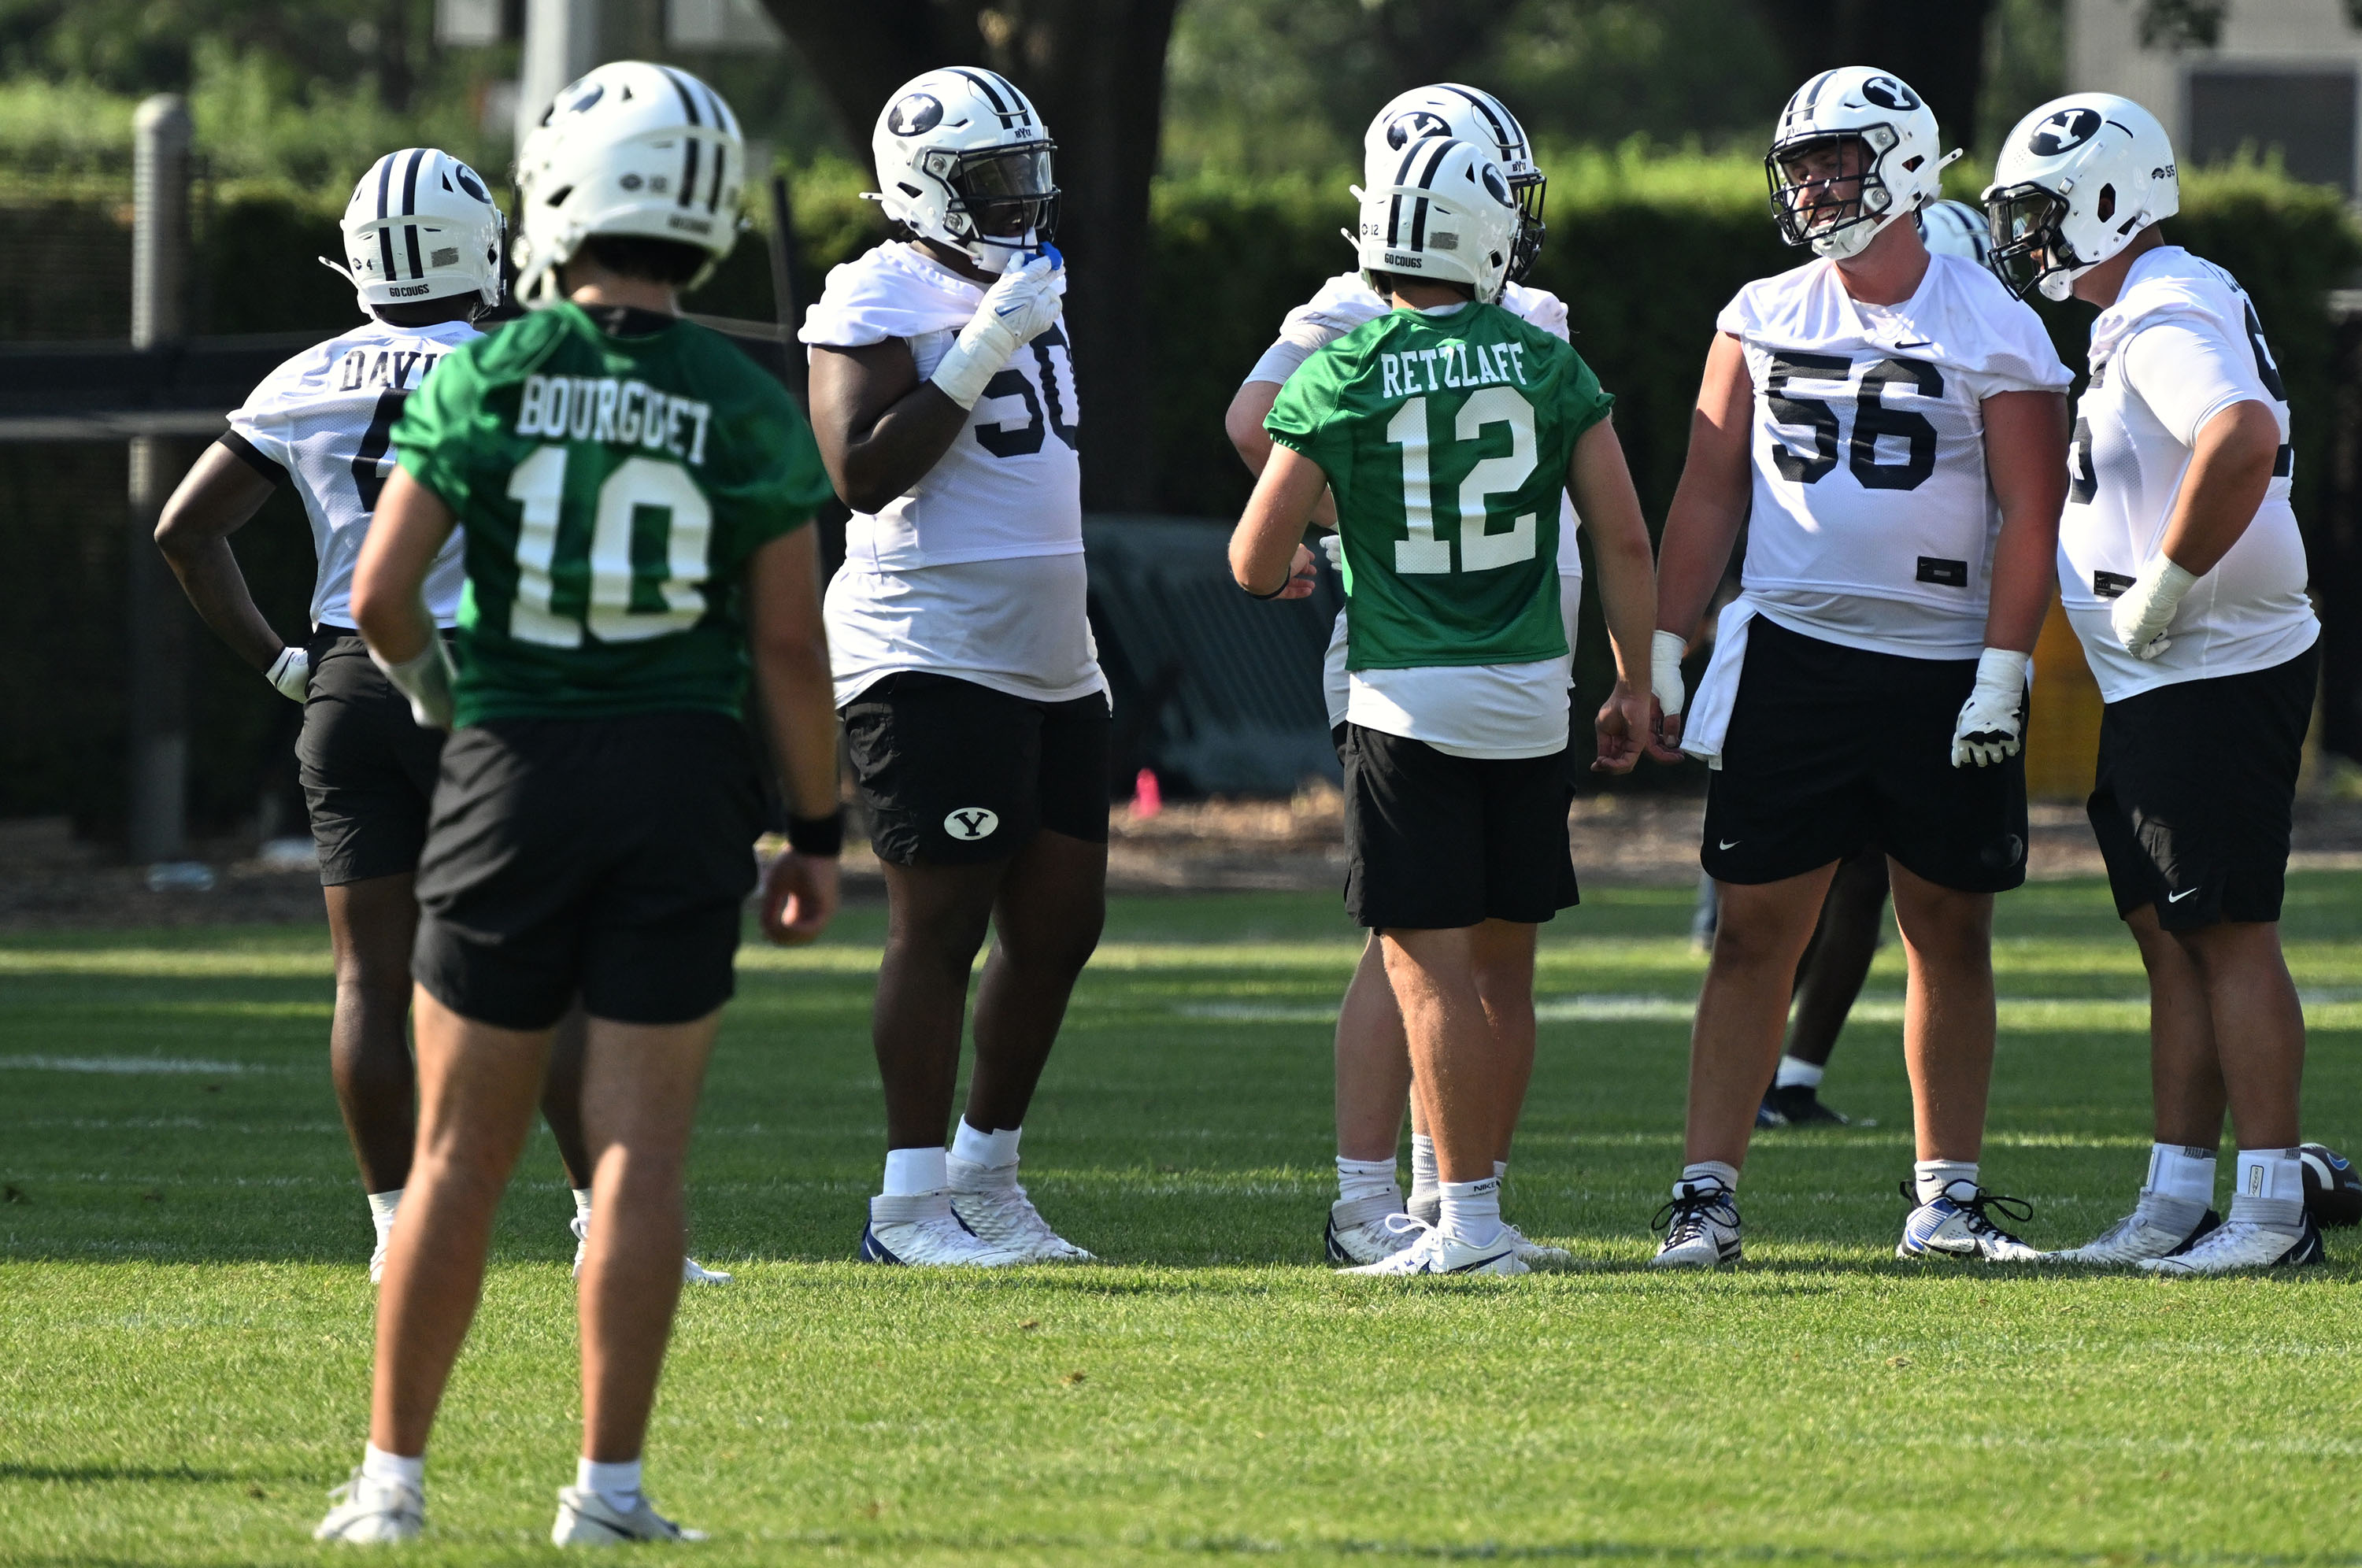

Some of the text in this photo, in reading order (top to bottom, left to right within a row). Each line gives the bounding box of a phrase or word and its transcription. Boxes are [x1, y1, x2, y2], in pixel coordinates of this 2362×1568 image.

[1868, 77, 1911, 107] Y
[897, 95, 936, 133] Y
[1014, 128, 1032, 139] BYU
[2034, 110, 2085, 150] Y
[1512, 160, 1527, 172] BYU
[2165, 165, 2175, 178] 55
[1371, 224, 1379, 235] 12
[366, 258, 373, 271] 4
[1384, 253, 1422, 268] GO COUGS
[389, 283, 430, 298] GO COUGS
[1381, 342, 1527, 398] RETZLAFF
[516, 375, 710, 466] BOURGUET
[1765, 352, 1944, 491] 56
[1386, 386, 1538, 574] 12
[505, 445, 713, 649] 10
[953, 812, 989, 837] Y
[1474, 1182, 1495, 1193] NIKE
